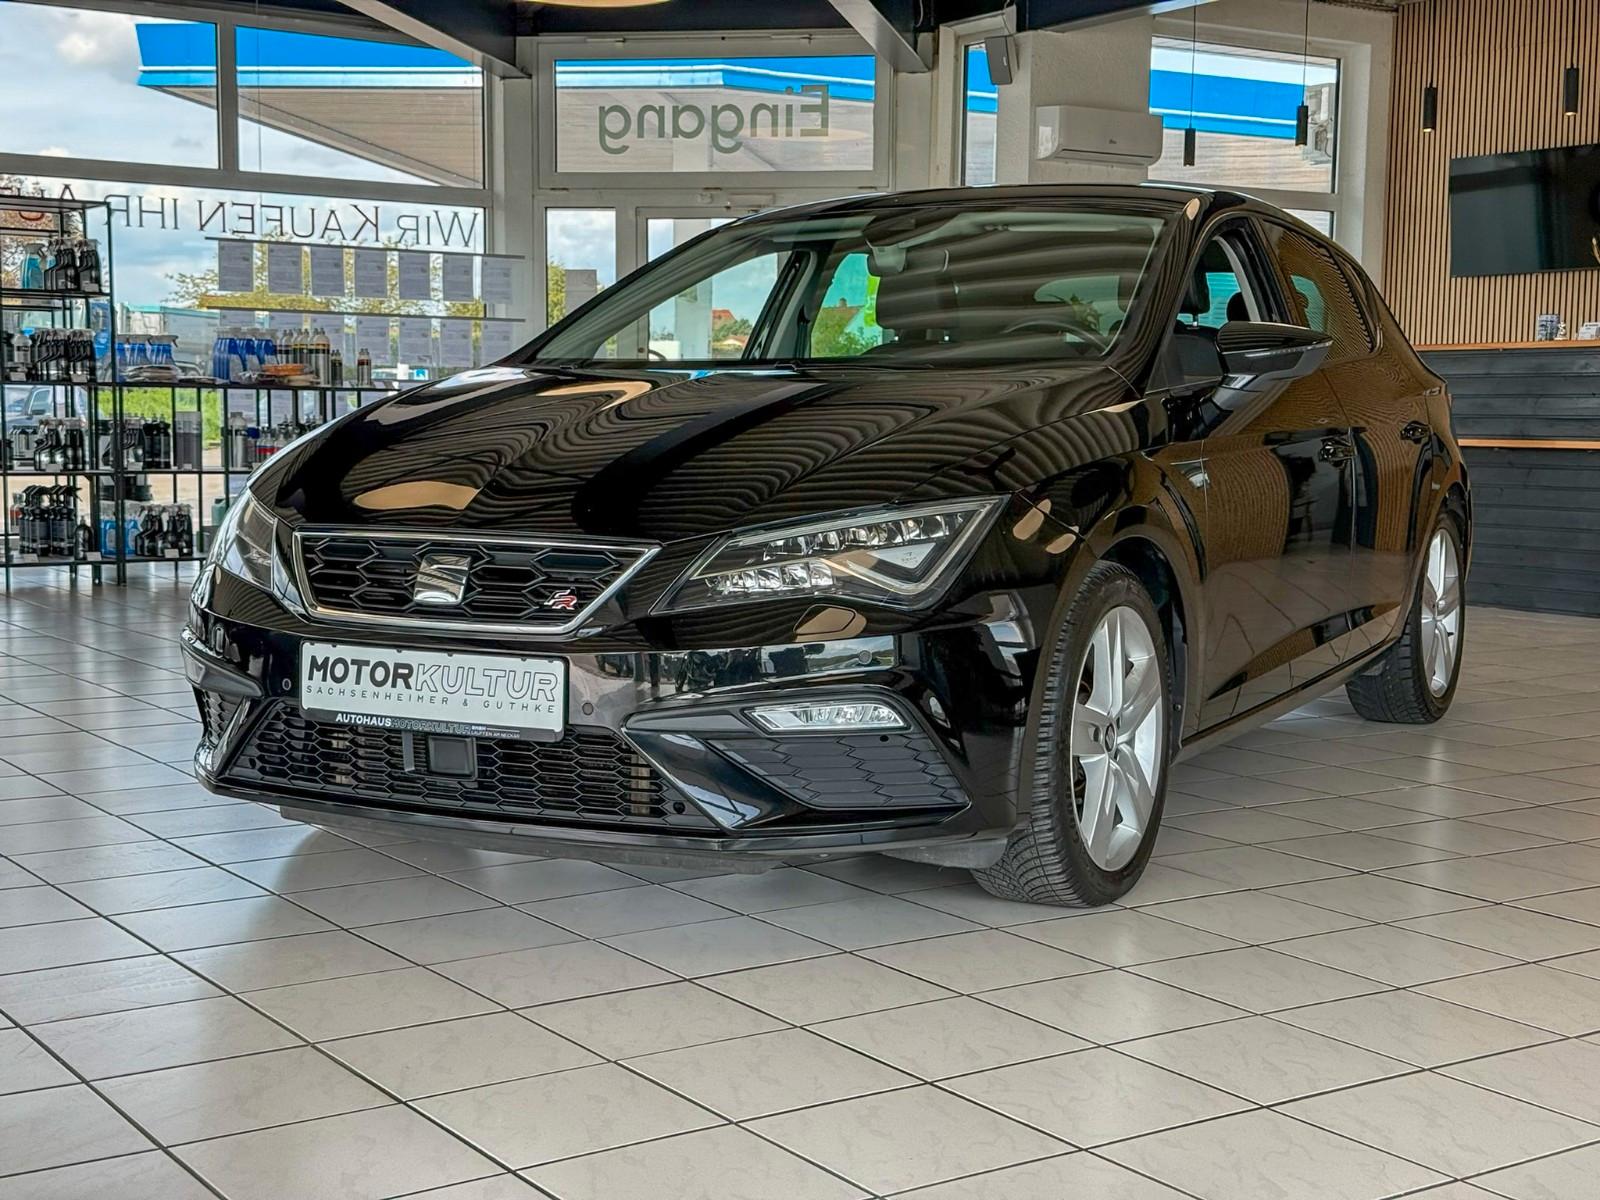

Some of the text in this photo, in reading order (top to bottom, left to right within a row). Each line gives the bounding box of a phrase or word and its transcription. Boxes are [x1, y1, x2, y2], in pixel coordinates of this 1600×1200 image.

[308, 655, 559, 702] MOTORKULTUR
[306, 685, 555, 714] SACHSENHEIMER & GUTHKE
